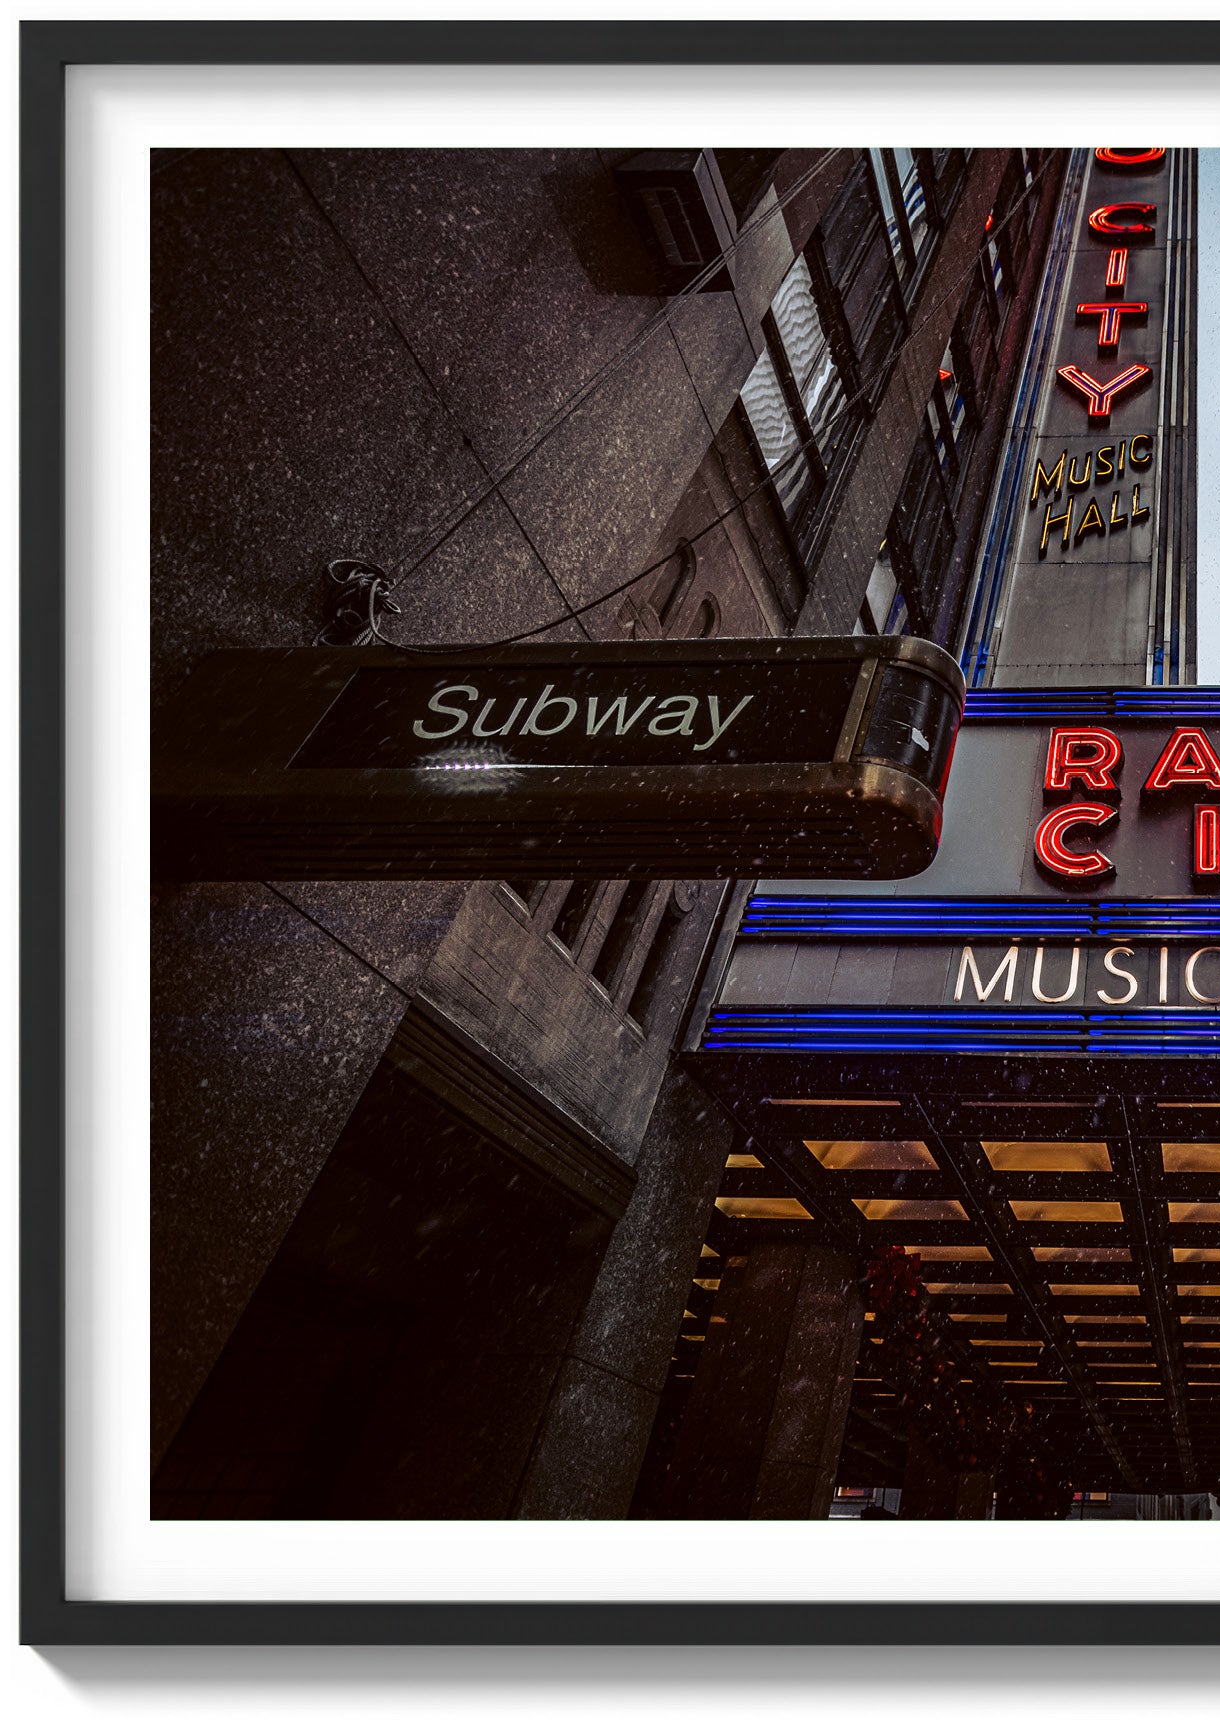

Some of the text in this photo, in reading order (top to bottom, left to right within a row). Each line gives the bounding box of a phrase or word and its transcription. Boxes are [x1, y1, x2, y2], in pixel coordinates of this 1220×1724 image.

[1056, 202, 1157, 424] CITY
[1031, 434, 1153, 506] MUSIC
[1039, 484, 1150, 556] HALL
[412, 684, 754, 751] Subway
